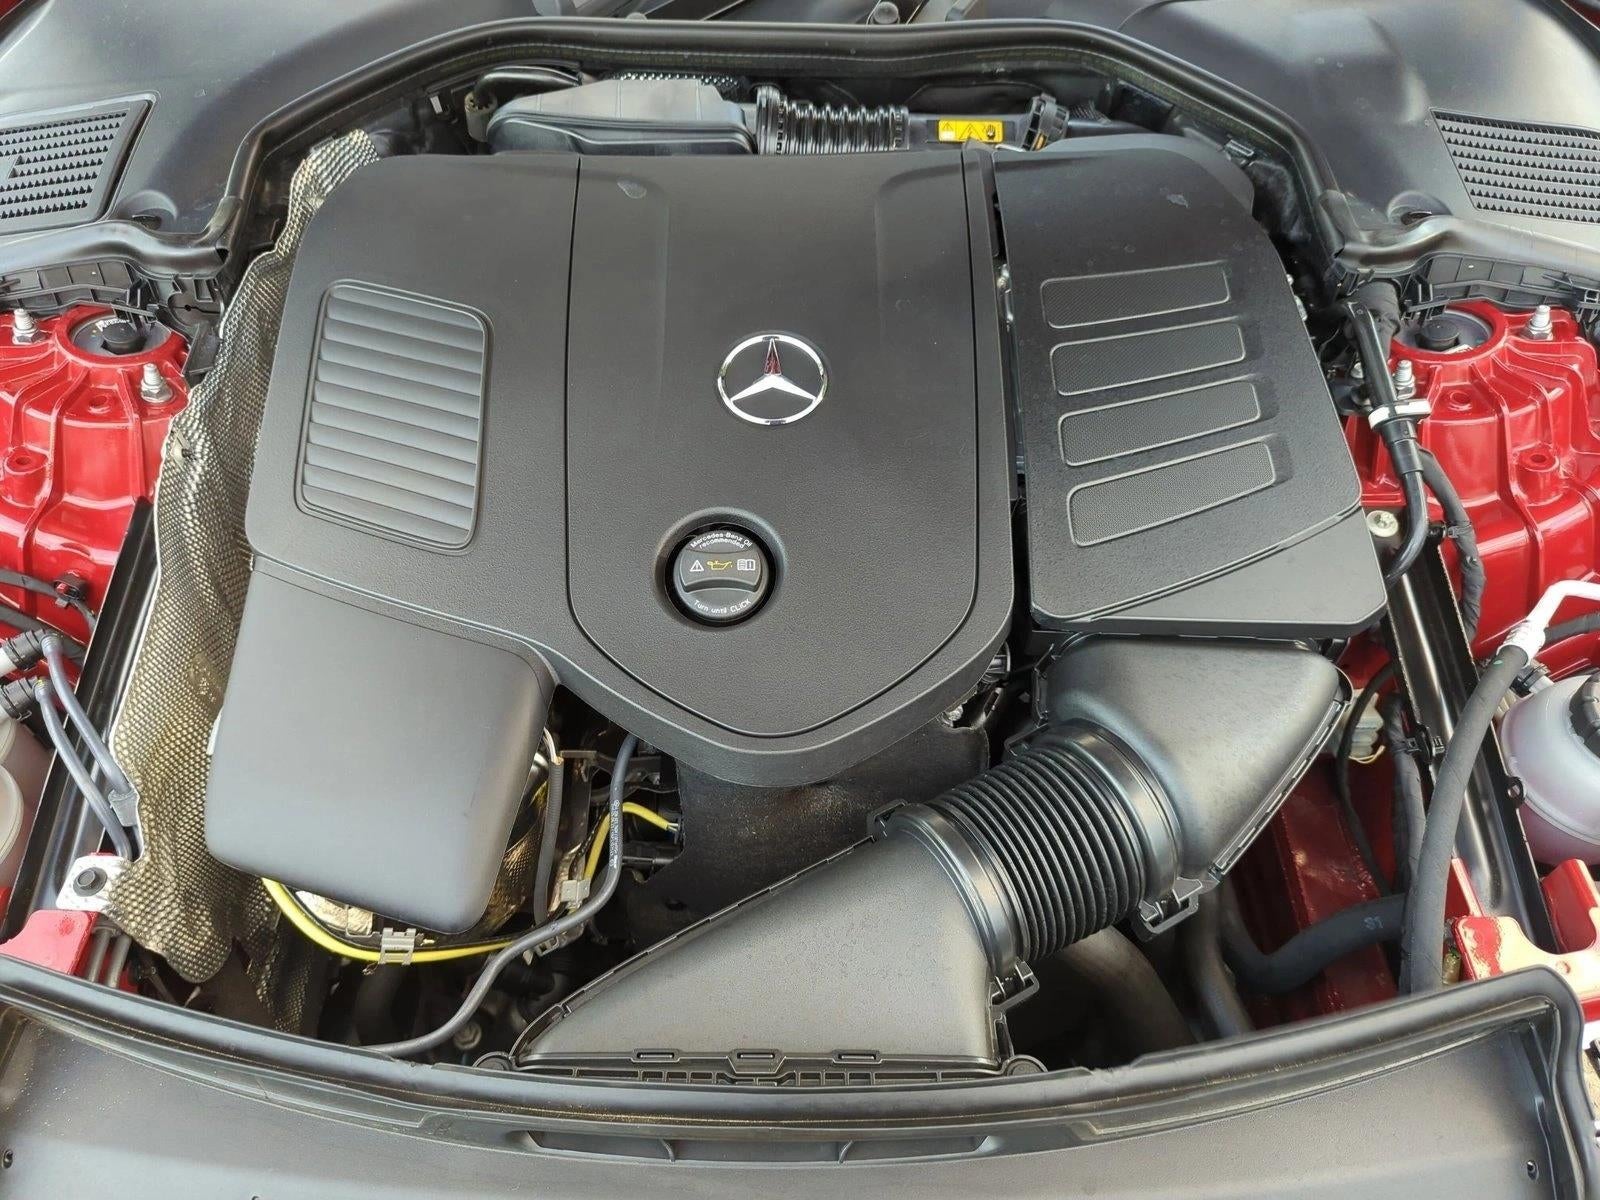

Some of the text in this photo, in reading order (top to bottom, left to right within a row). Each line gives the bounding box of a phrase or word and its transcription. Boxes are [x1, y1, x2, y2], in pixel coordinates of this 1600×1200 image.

[699, 538, 745, 549] recommended
[743, 539, 753, 548] Oil
[694, 599, 709, 612] Turn
